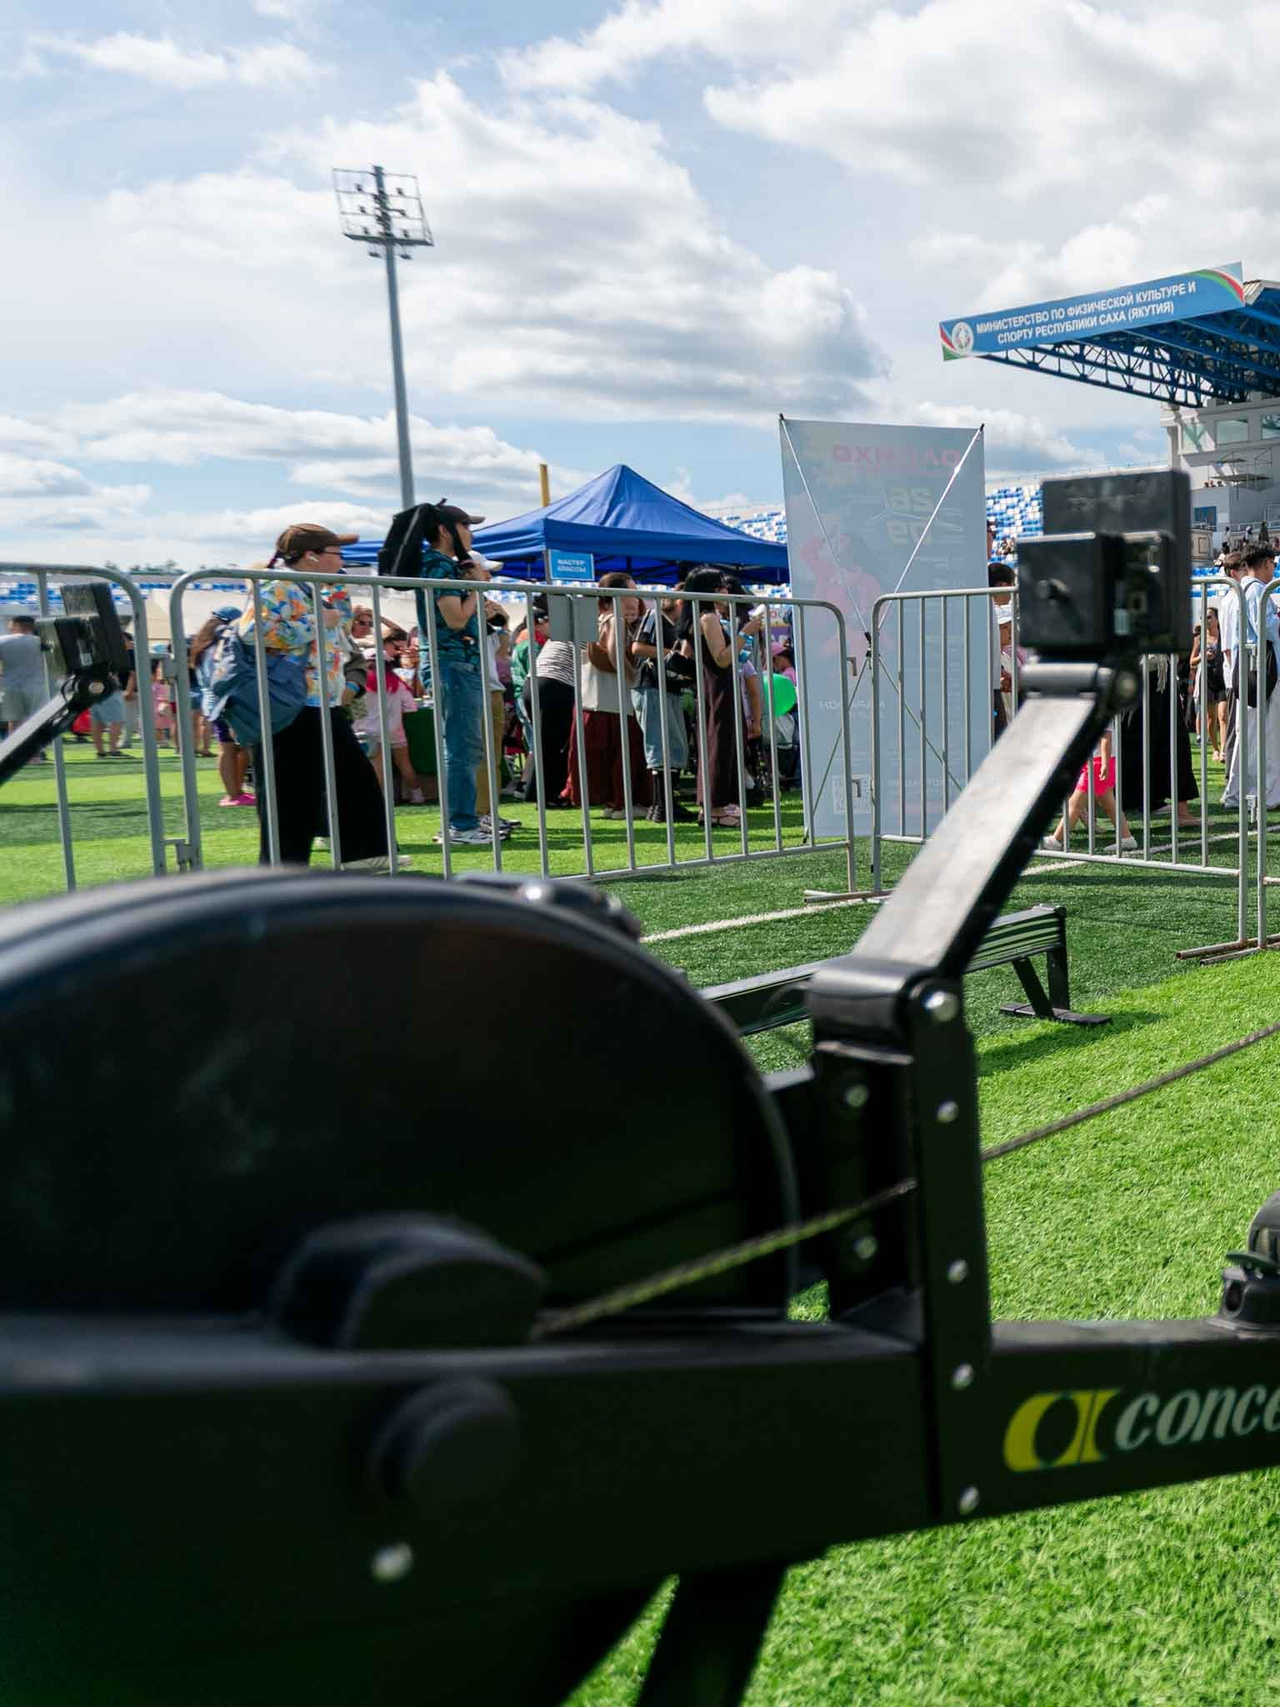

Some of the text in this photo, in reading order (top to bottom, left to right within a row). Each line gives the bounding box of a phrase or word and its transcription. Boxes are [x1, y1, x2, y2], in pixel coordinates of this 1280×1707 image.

[976, 281, 1197, 334] МИНИСТЕРСТВО ПО ФИЗИЧЕСКОЙ КУЛЬТУРЕ И
[997, 301, 1174, 344] СПОРТУ РЕСПУБЛИКИ САХА (ЯКУТИЯ)
